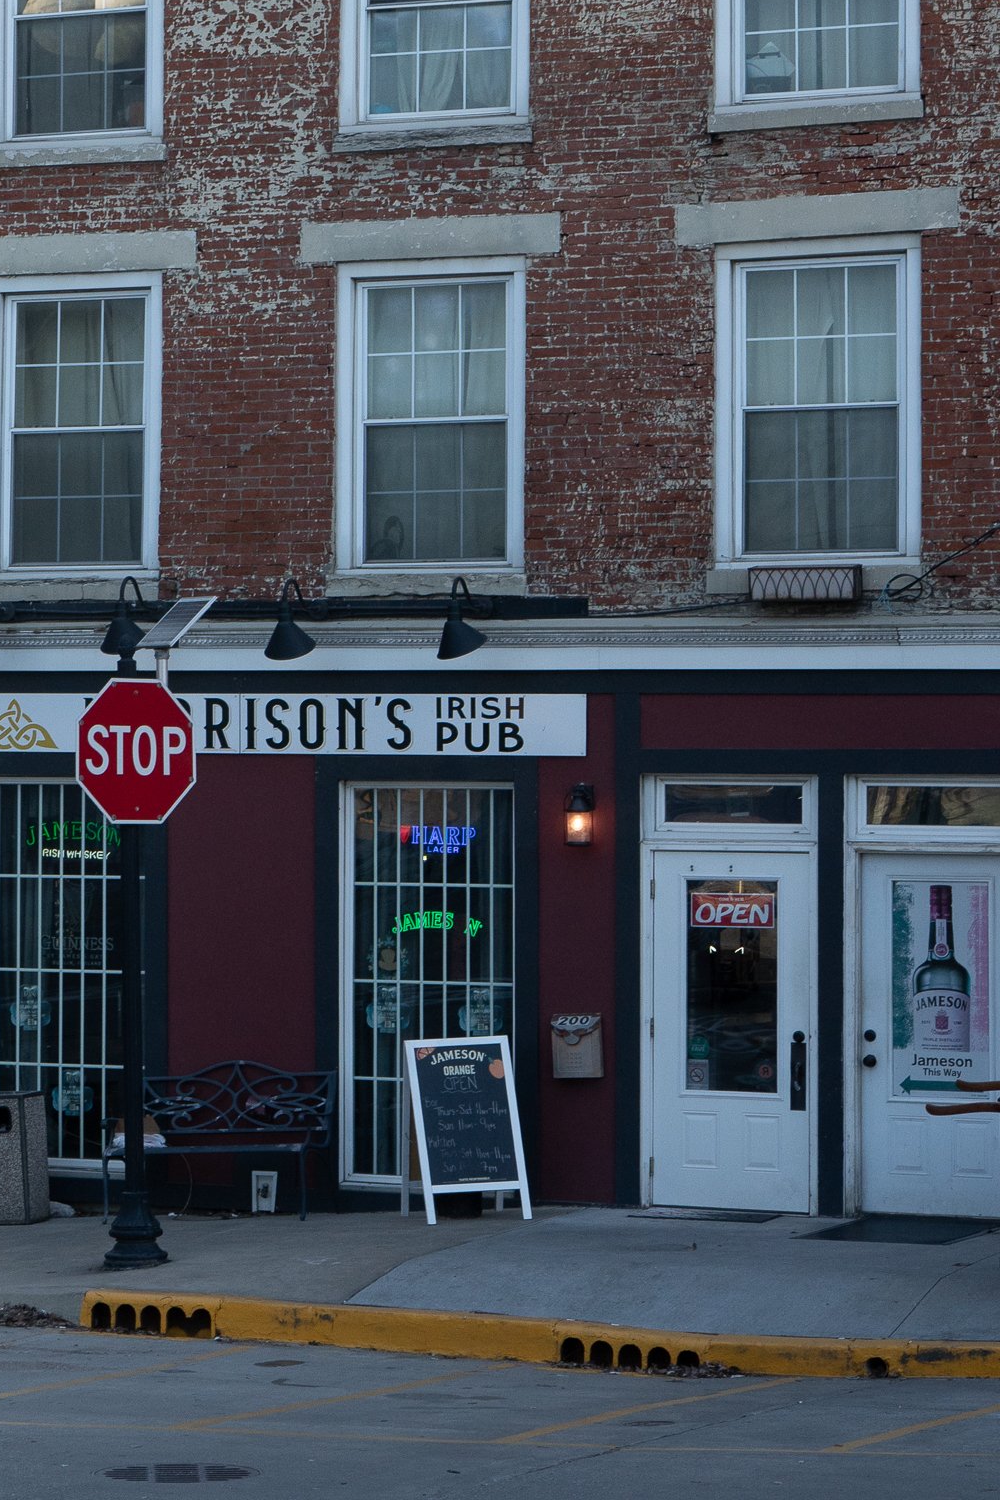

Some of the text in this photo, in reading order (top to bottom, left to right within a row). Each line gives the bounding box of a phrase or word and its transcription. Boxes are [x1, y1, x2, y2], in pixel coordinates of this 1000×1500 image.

[436, 696, 525, 720] IRISH
[436, 722, 524, 753] PUB
[86, 725, 187, 776] STOP
[26, 821, 121, 847] JAMESON
[411, 825, 476, 846] HARP
[42, 848, 111, 860] RISH WHSKEY
[695, 902, 769, 924] OPEN
[916, 995, 968, 1012] JAMESON
[558, 1016, 590, 1026] 200
[430, 1049, 484, 1065] JAMESON
[912, 1054, 973, 1067] Jameson
[443, 1065, 476, 1076] ORANGE
[923, 1068, 962, 1078] This Way
[444, 1076, 478, 1090] OPEN
